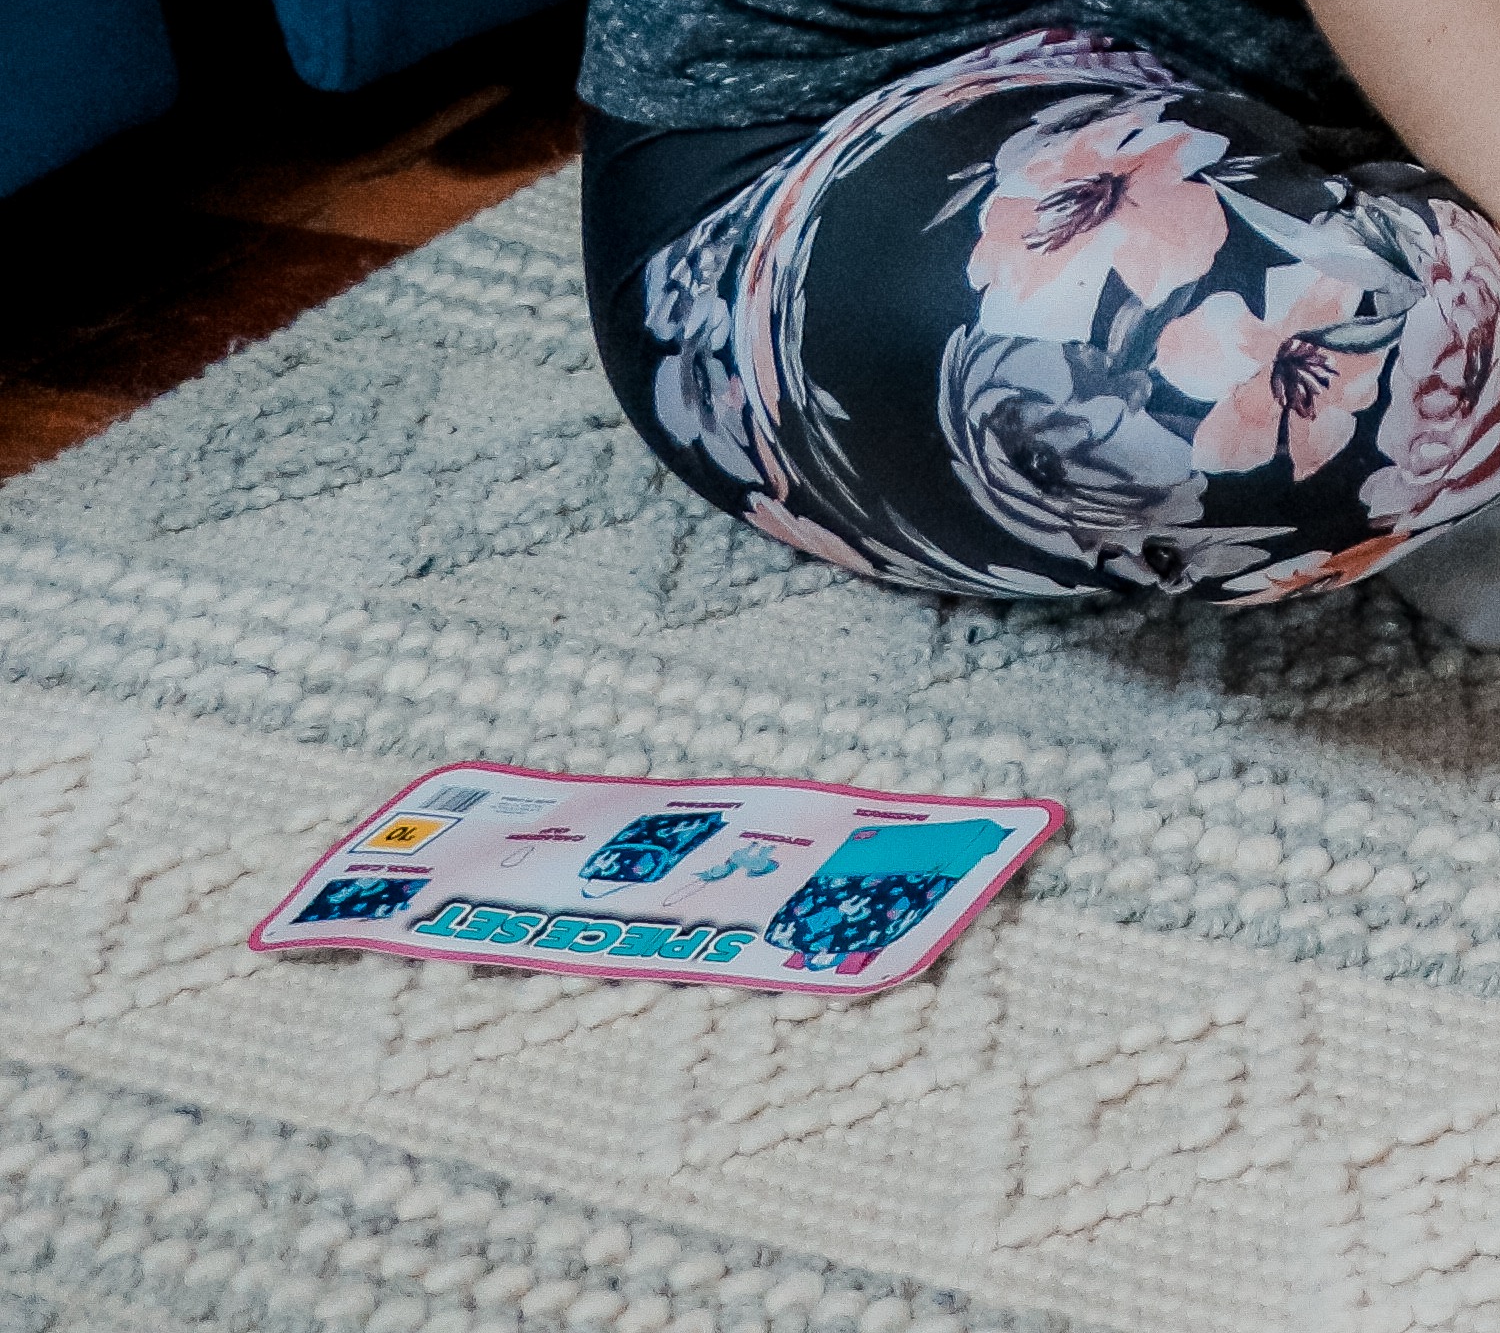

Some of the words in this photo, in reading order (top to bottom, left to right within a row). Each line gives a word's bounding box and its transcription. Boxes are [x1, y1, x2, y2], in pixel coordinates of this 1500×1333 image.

[416, 903, 546, 945] SET
[528, 916, 706, 961] PIECE
[705, 930, 758, 963] 5
